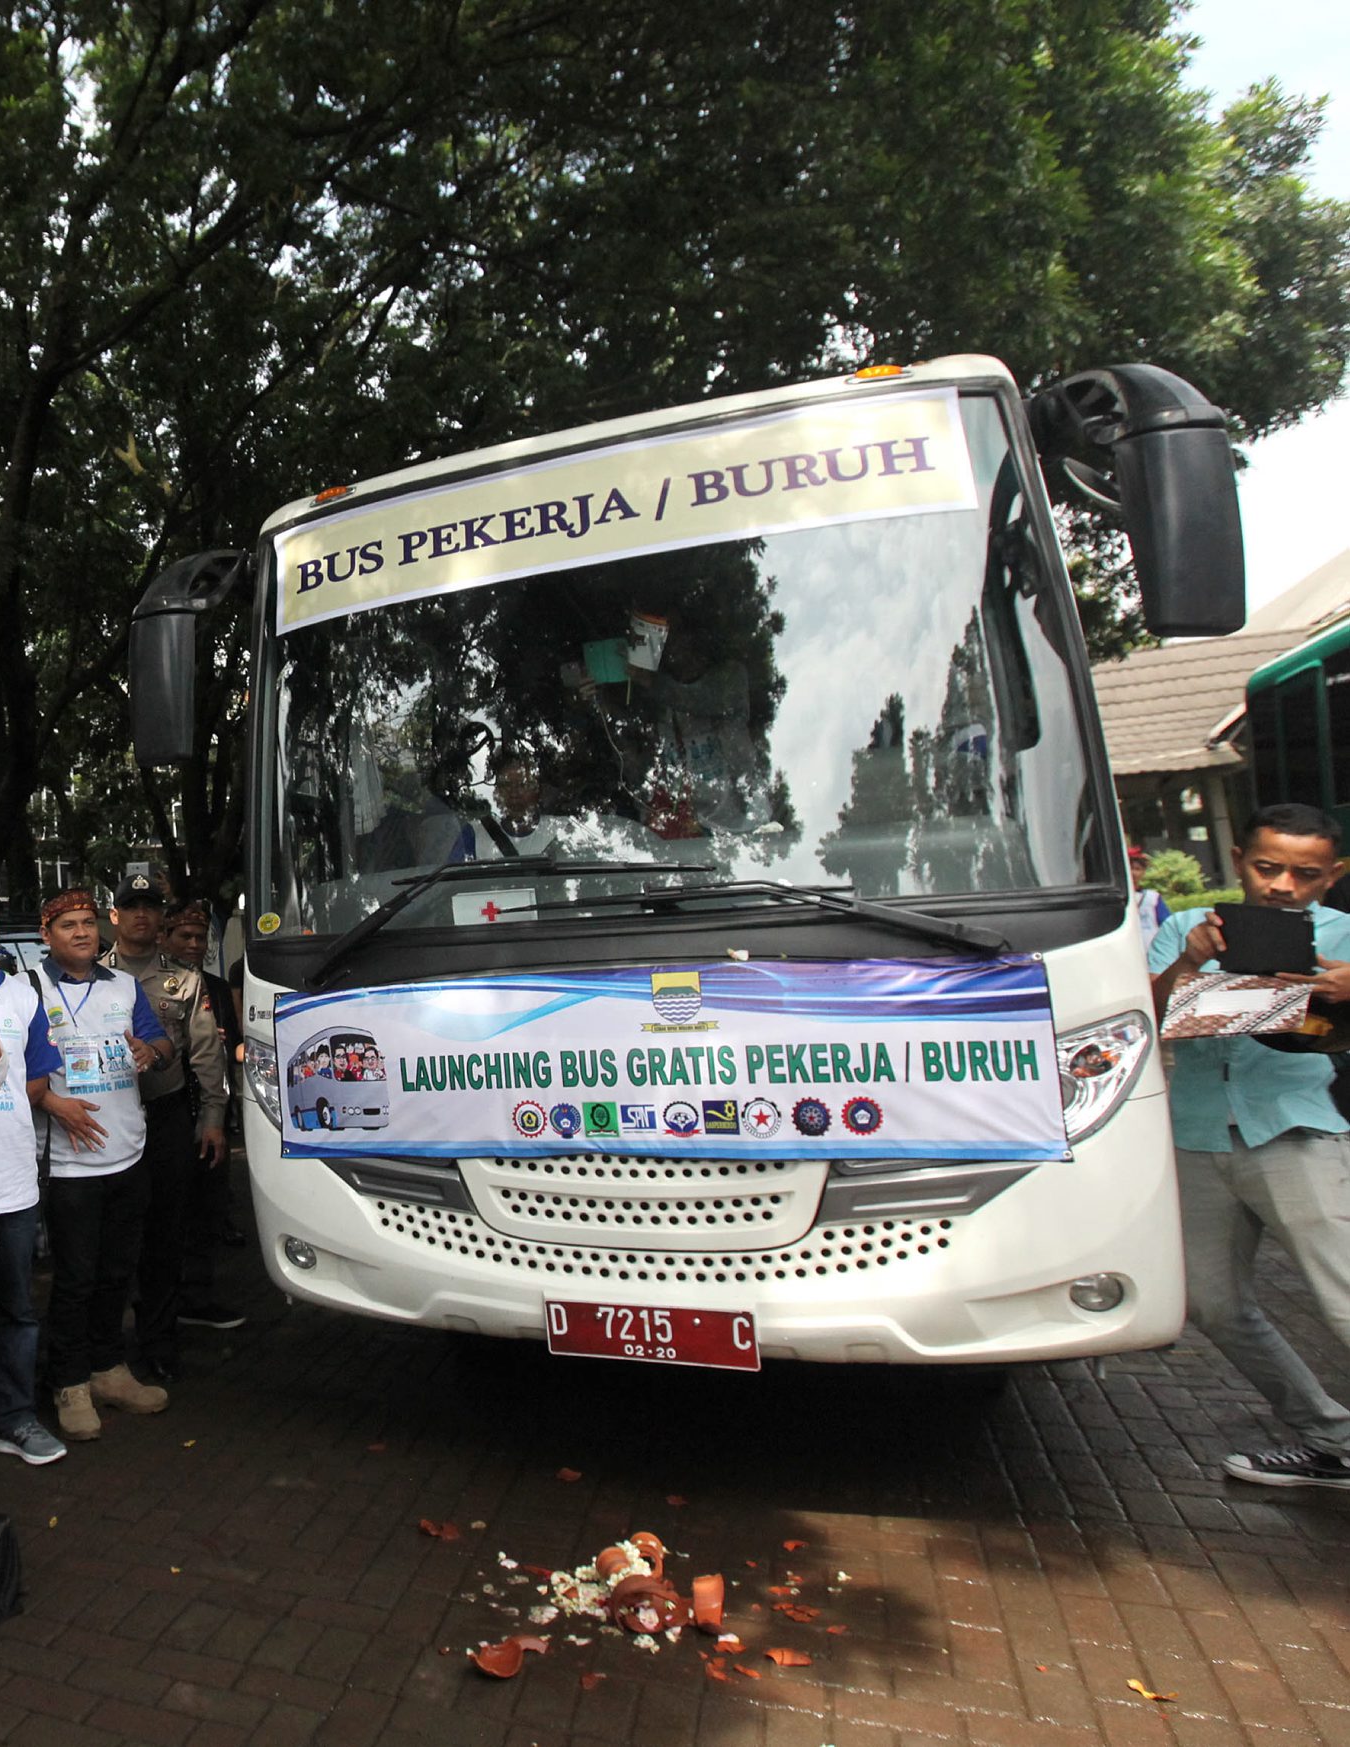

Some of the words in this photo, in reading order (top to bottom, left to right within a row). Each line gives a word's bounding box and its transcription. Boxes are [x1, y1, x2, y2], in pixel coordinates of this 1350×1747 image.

[297, 540, 384, 595] BUS
[398, 488, 640, 567] PEKERJA
[655, 477, 672, 521] /
[688, 436, 935, 508] BURUH
[400, 1048, 553, 1092] LAUNCHING
[561, 1047, 619, 1089] BUS
[625, 1045, 738, 1087] GRATIS
[747, 1041, 897, 1085] PEKERJA
[904, 1041, 913, 1083] /
[922, 1040, 1040, 1083] BURUH
[549, 1304, 568, 1336] D
[598, 1307, 674, 1343] 7215
[732, 1317, 752, 1350] C
